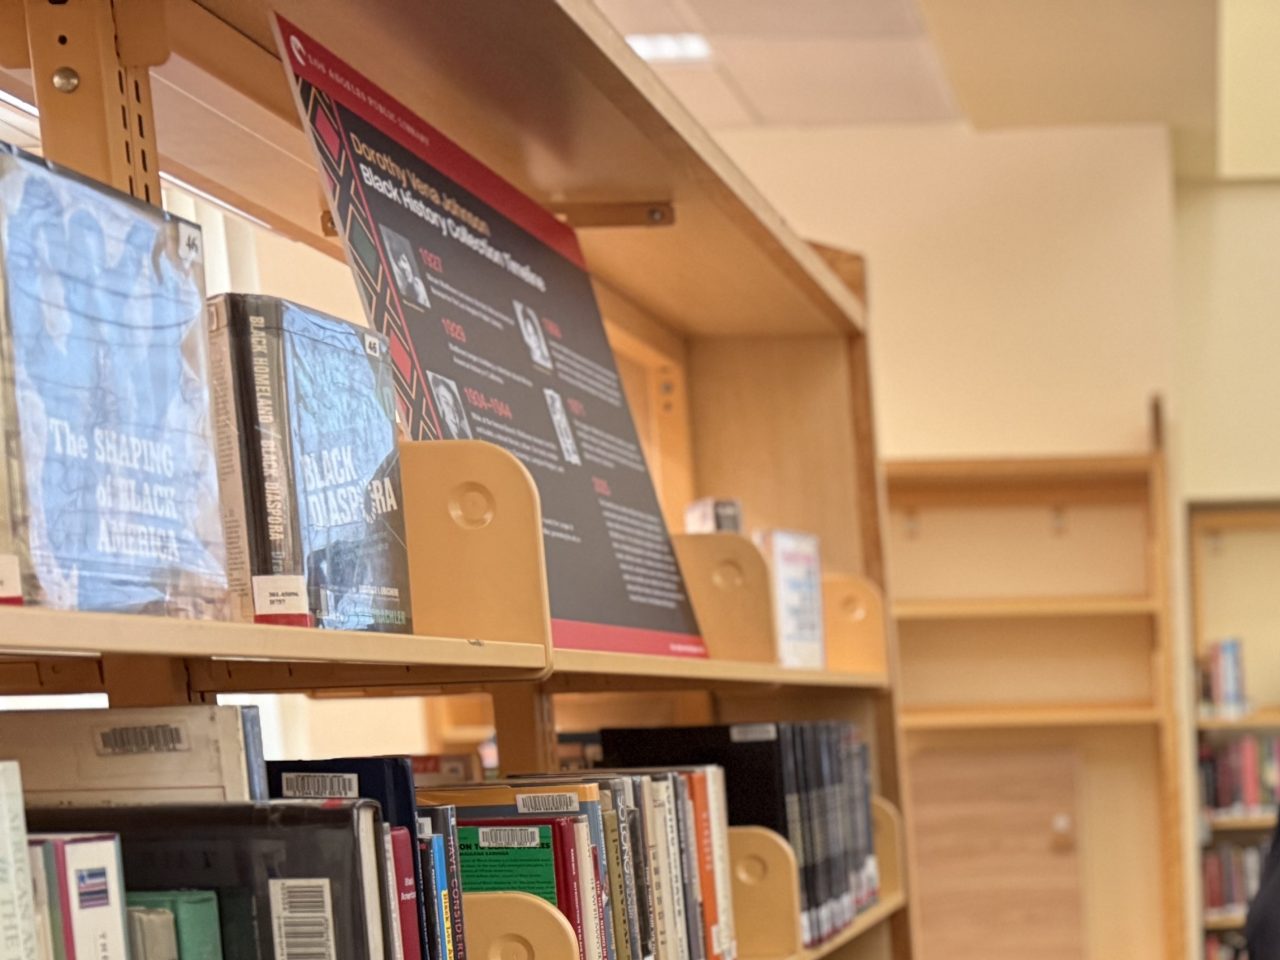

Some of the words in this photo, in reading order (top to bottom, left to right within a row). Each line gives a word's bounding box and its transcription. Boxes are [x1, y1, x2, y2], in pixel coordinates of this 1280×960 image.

[348, 131, 410, 189] Dorothy
[405, 167, 442, 207] Vena
[437, 188, 493, 240] Johnson
[357, 160, 402, 205] Black
[398, 186, 450, 239] History
[444, 214, 506, 269] Collection
[250, 315, 266, 354] BLACK
[253, 356, 274, 424] HOMELAND
[50, 417, 88, 459] The
[94, 428, 174, 478] SHAPING
[260, 439, 279, 479] BLACK
[302, 446, 358, 491] BLACK
[96, 474, 112, 511] of
[116, 476, 178, 520] BLACK
[266, 480, 284, 541] DIASPORA
[308, 477, 398, 529] DIASPORA
[97, 518, 180, 562] AMERICA
[616, 795, 627, 821] SO
[8, 810, 31, 923] AFRICAN
[447, 836, 455, 872] HAVE
[619, 823, 632, 874] LONG
[0, 897, 20, 950] THE
